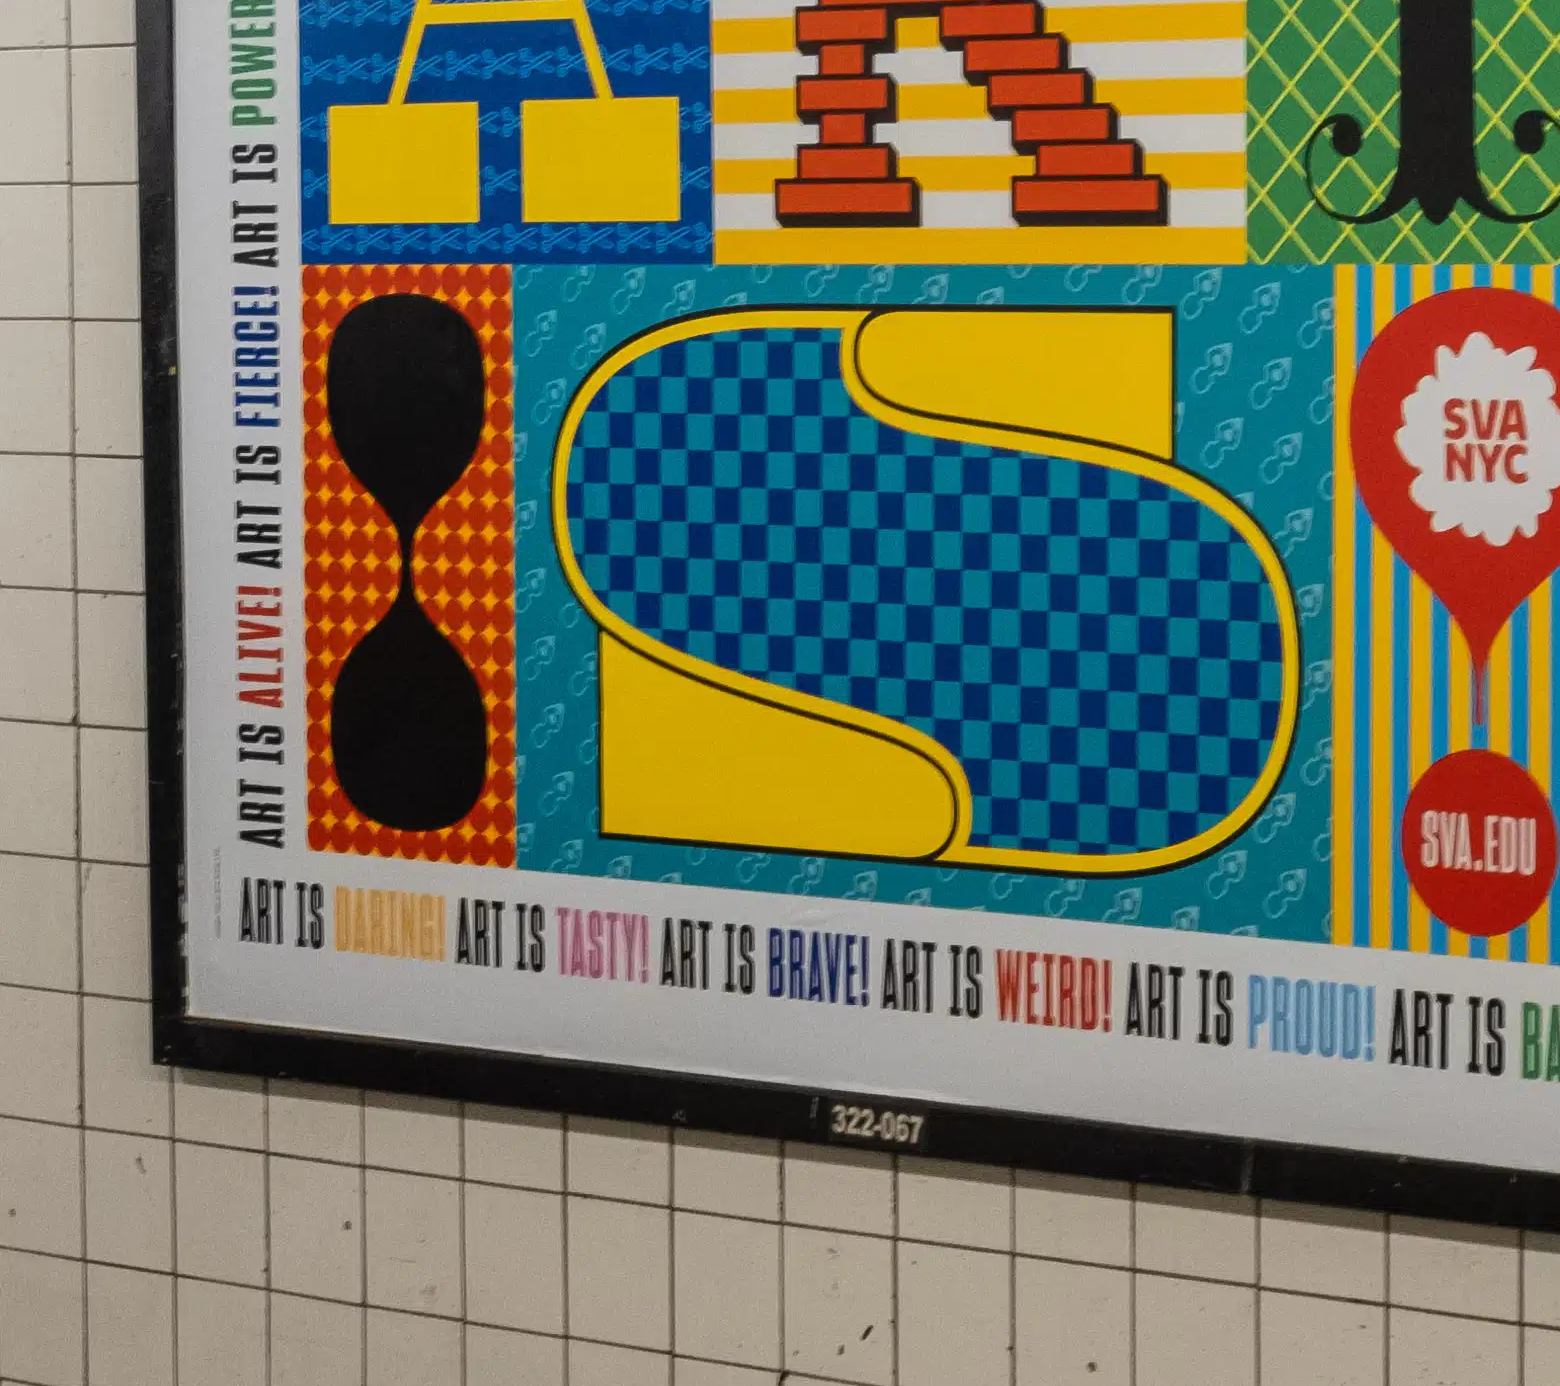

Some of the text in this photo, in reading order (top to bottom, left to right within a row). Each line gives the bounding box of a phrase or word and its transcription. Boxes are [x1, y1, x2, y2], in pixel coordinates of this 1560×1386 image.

[231, 143, 278, 184] IS
[231, 200, 279, 268] ART
[232, 285, 280, 427] FIERCE!
[1443, 398, 1528, 442] SVA
[234, 445, 282, 484] IS
[1444, 443, 1528, 485] NYC
[235, 500, 282, 569] ART
[236, 585, 284, 708] ALIVE!
[238, 723, 284, 765] IS
[238, 779, 284, 849] ART
[1420, 810, 1536, 876] SVA.EDU
[239, 877, 286, 945] ART
[295, 881, 325, 949] IS
[334, 885, 446, 962] DARING!
[455, 897, 506, 968] ART
[514, 903, 546, 973] IS
[556, 906, 649, 985] TASTY!
[659, 917, 714, 990] ART
[722, 923, 756, 995] IS
[766, 927, 871, 1007] BRAVE!
[881, 938, 937, 1013] ART
[947, 944, 982, 1018] IS
[994, 948, 1113, 1033] WEIRD!
[1124, 962, 1185, 1040] ART
[1196, 968, 1234, 1046] IS
[1246, 974, 1377, 1062] PROUD!
[1388, 988, 1454, 1071] ART
[1465, 995, 1506, 1077] IS
[831, 1104, 924, 1144] 322-067
